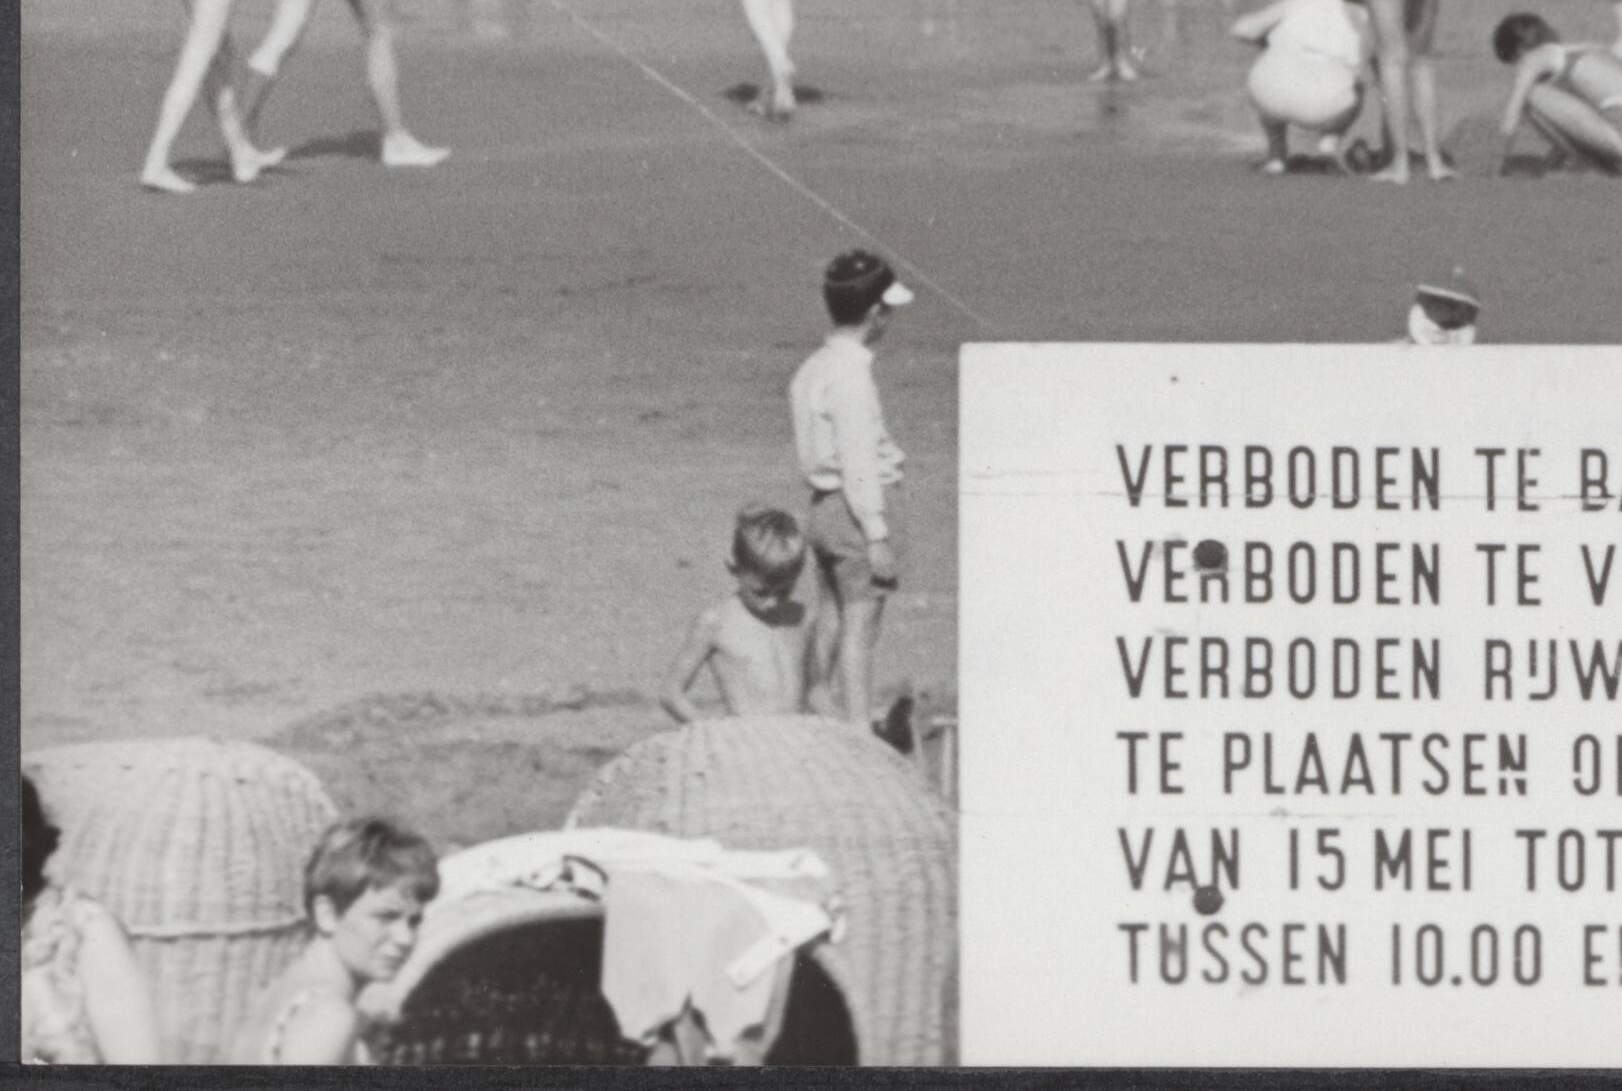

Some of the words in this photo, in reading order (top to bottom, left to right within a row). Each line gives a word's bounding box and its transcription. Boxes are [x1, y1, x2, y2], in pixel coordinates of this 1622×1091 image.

[1116, 444, 1440, 511] VERBODEN
[1475, 448, 1540, 512] TE
[1476, 543, 1541, 606] TE
[1116, 636, 1440, 700] VERBODEN
[1117, 731, 1183, 794] TE
[1224, 732, 1527, 796] PLAATSEN
[1118, 828, 1239, 891] VAN
[1290, 828, 1345, 891] 15
[1375, 828, 1471, 891] MEI
[1119, 922, 1346, 985] TUSSEN
[1392, 924, 1541, 986] 10.00
